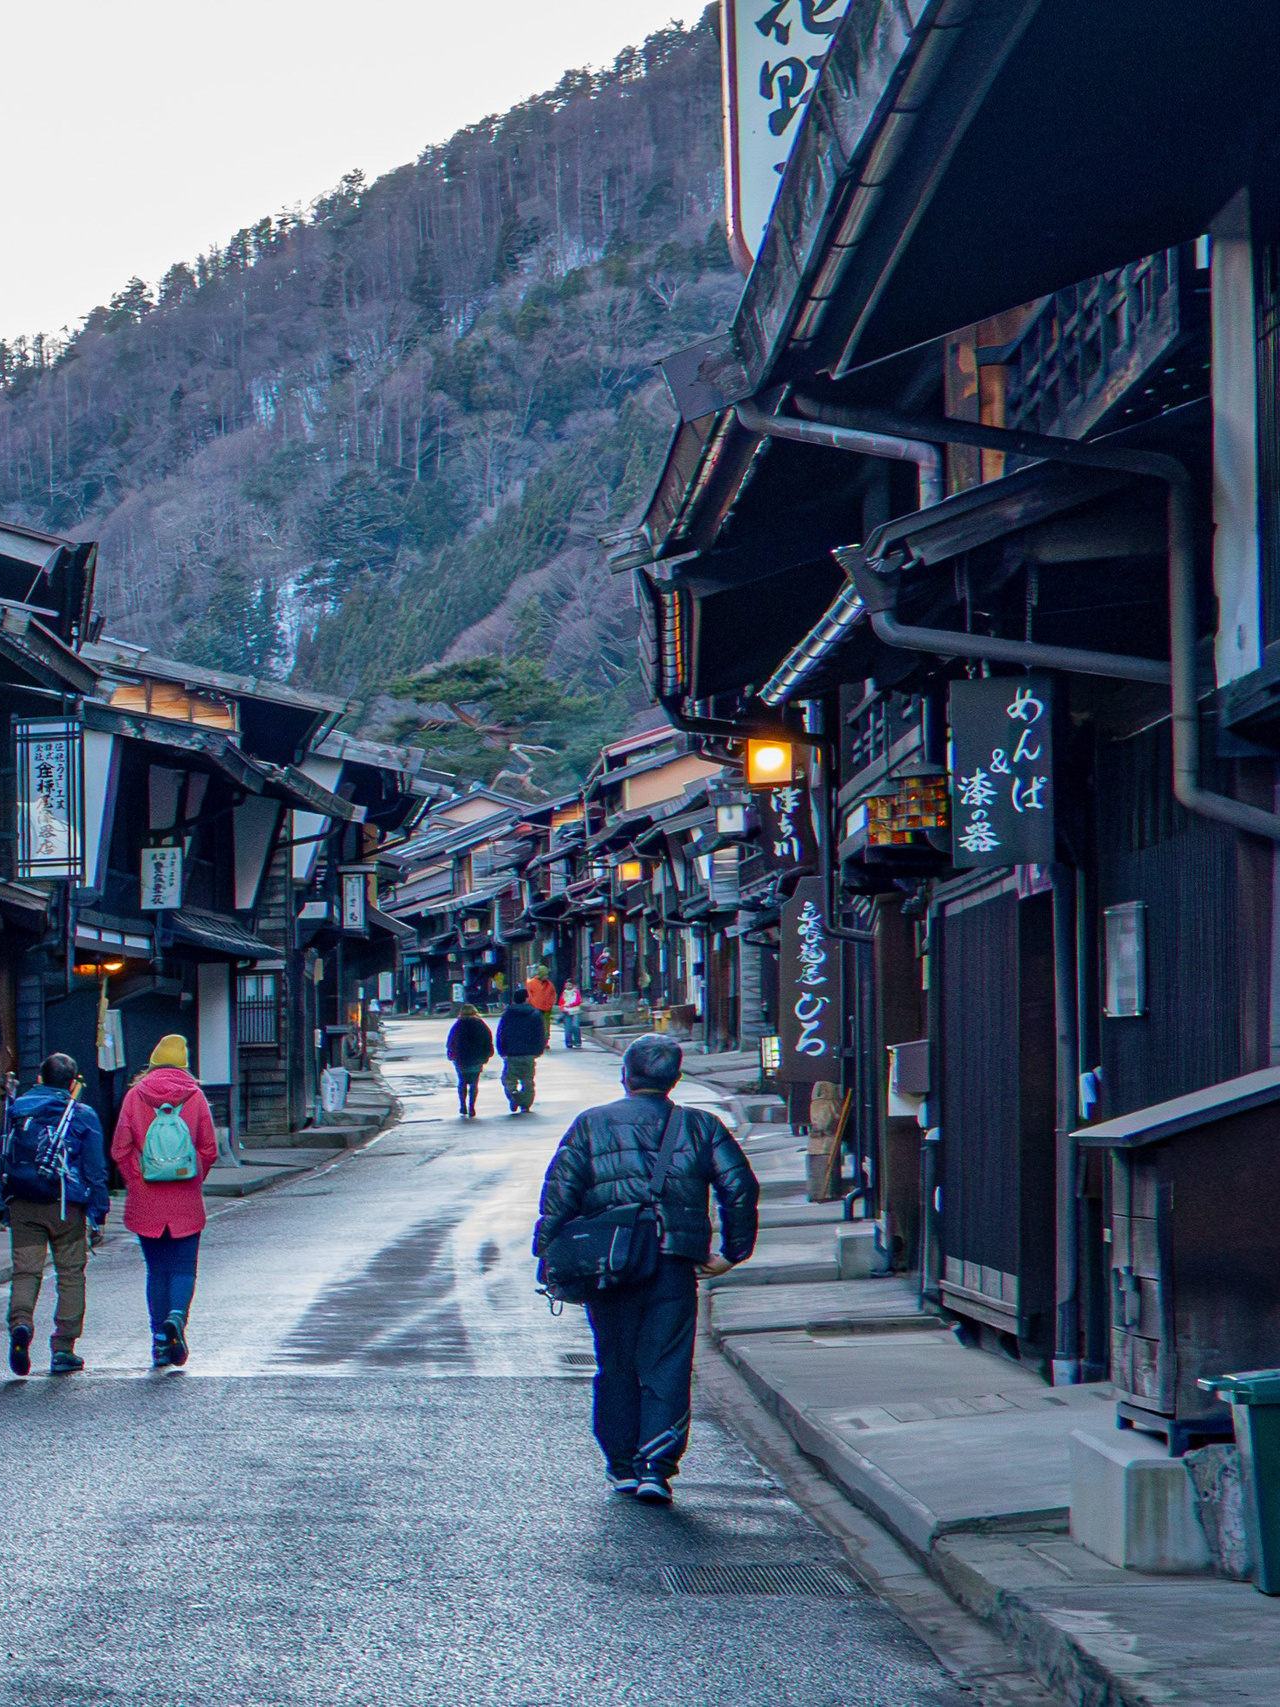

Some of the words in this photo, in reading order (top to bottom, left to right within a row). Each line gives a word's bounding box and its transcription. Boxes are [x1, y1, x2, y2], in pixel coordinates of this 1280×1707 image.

[990, 748, 1012, 775] &
[1006, 686, 1048, 813] めんぱ
[957, 767, 1002, 852] 漆の器
